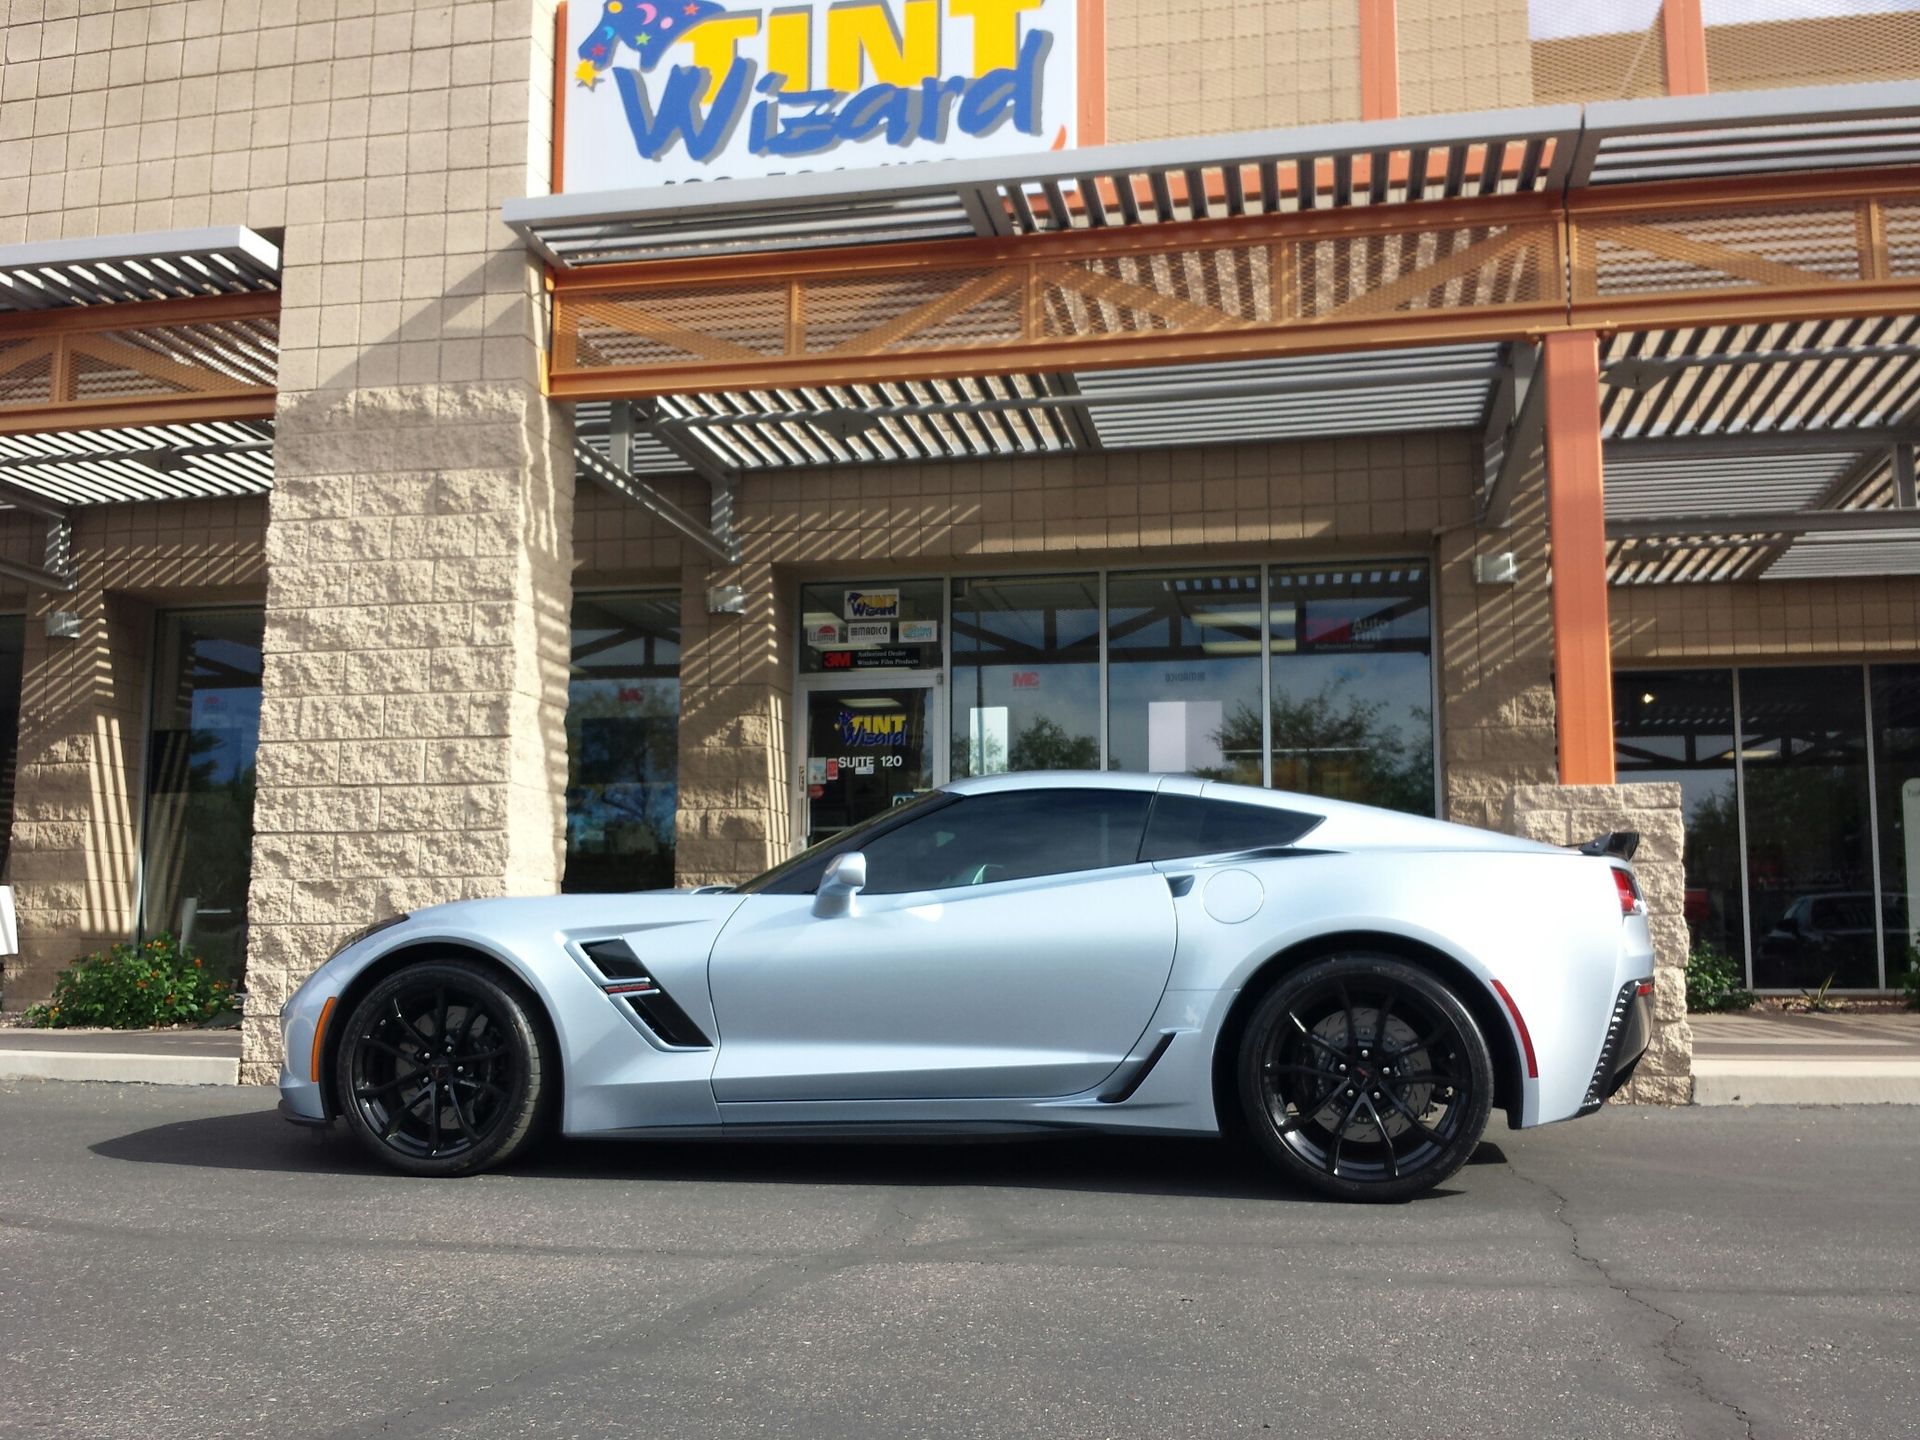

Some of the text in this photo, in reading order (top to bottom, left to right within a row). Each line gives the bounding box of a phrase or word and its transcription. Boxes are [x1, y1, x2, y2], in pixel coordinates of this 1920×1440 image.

[676, 0, 1048, 106] TINT
[612, 29, 1055, 164] Wizard
[824, 652, 851, 668] 3M
[841, 722, 909, 747] Wizard
[850, 713, 907, 736] TINT
[838, 755, 903, 768] SUITE 120
